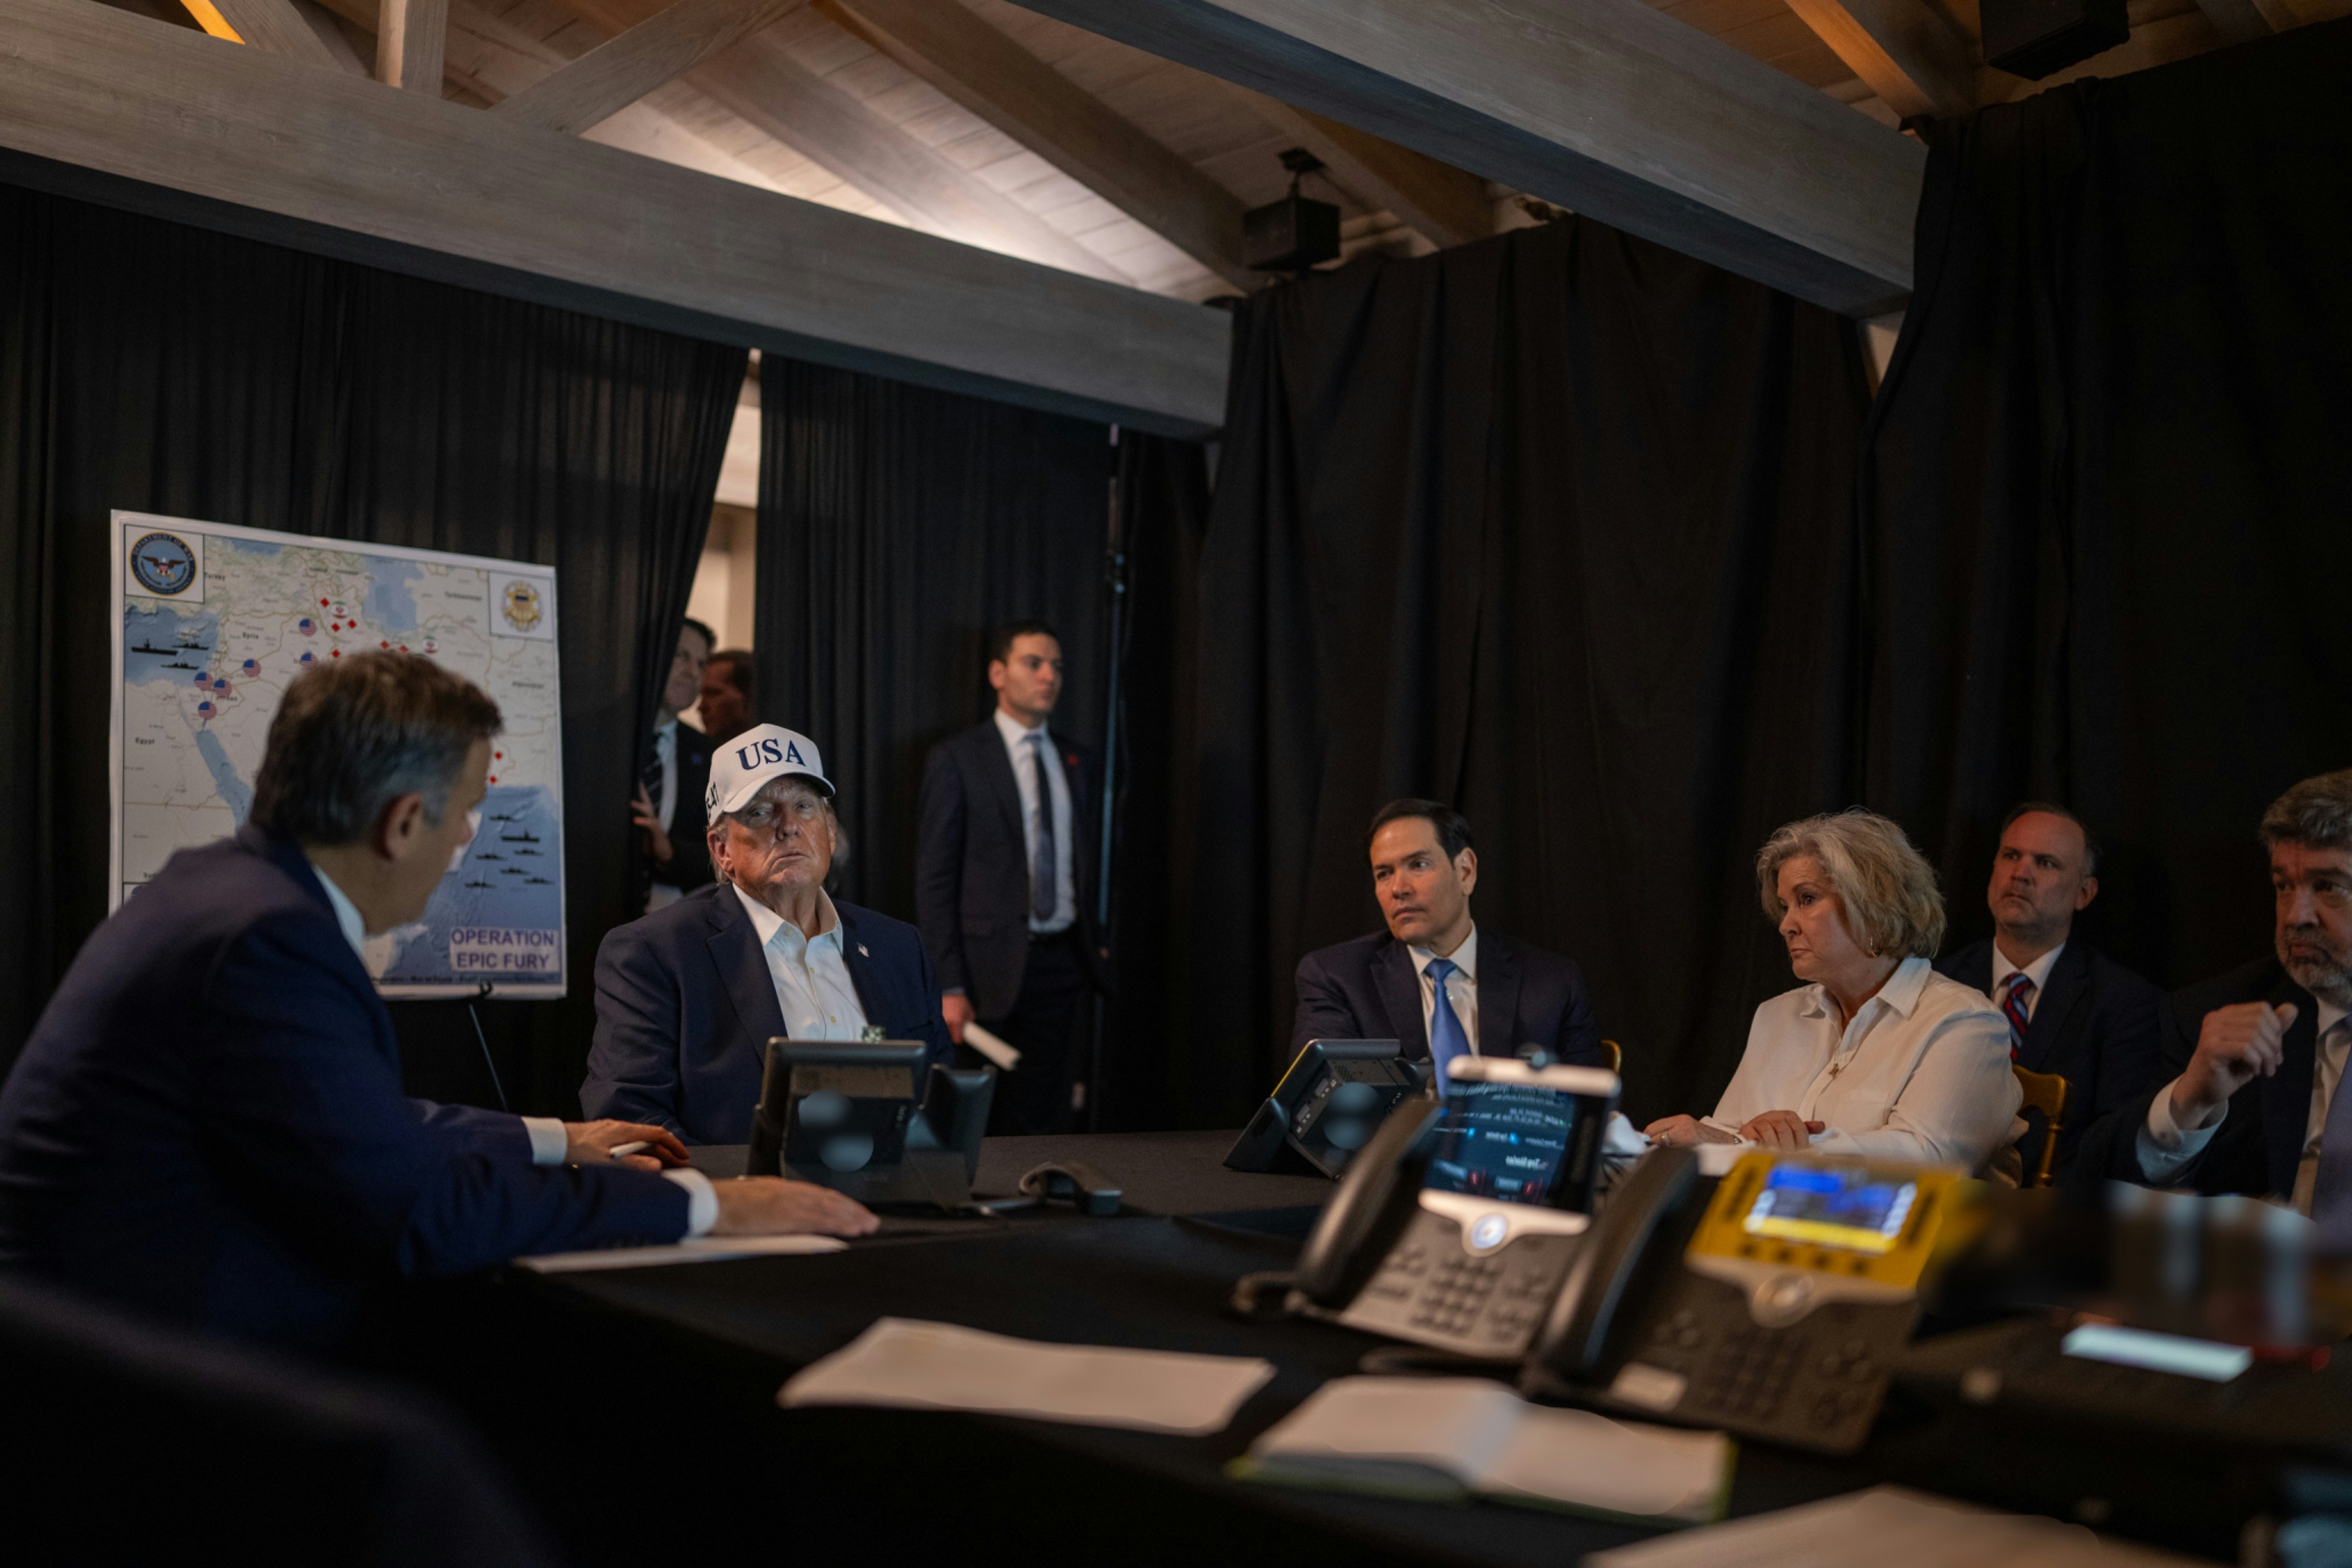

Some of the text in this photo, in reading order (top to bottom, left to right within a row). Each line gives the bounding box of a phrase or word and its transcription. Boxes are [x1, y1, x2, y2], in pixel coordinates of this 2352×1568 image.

[242, 632, 259, 640] Syria
[135, 737, 154, 745] Egypt
[736, 738, 806, 771] USA
[452, 929, 554, 946] OPERATION
[457, 952, 550, 969] EPIC FURY
